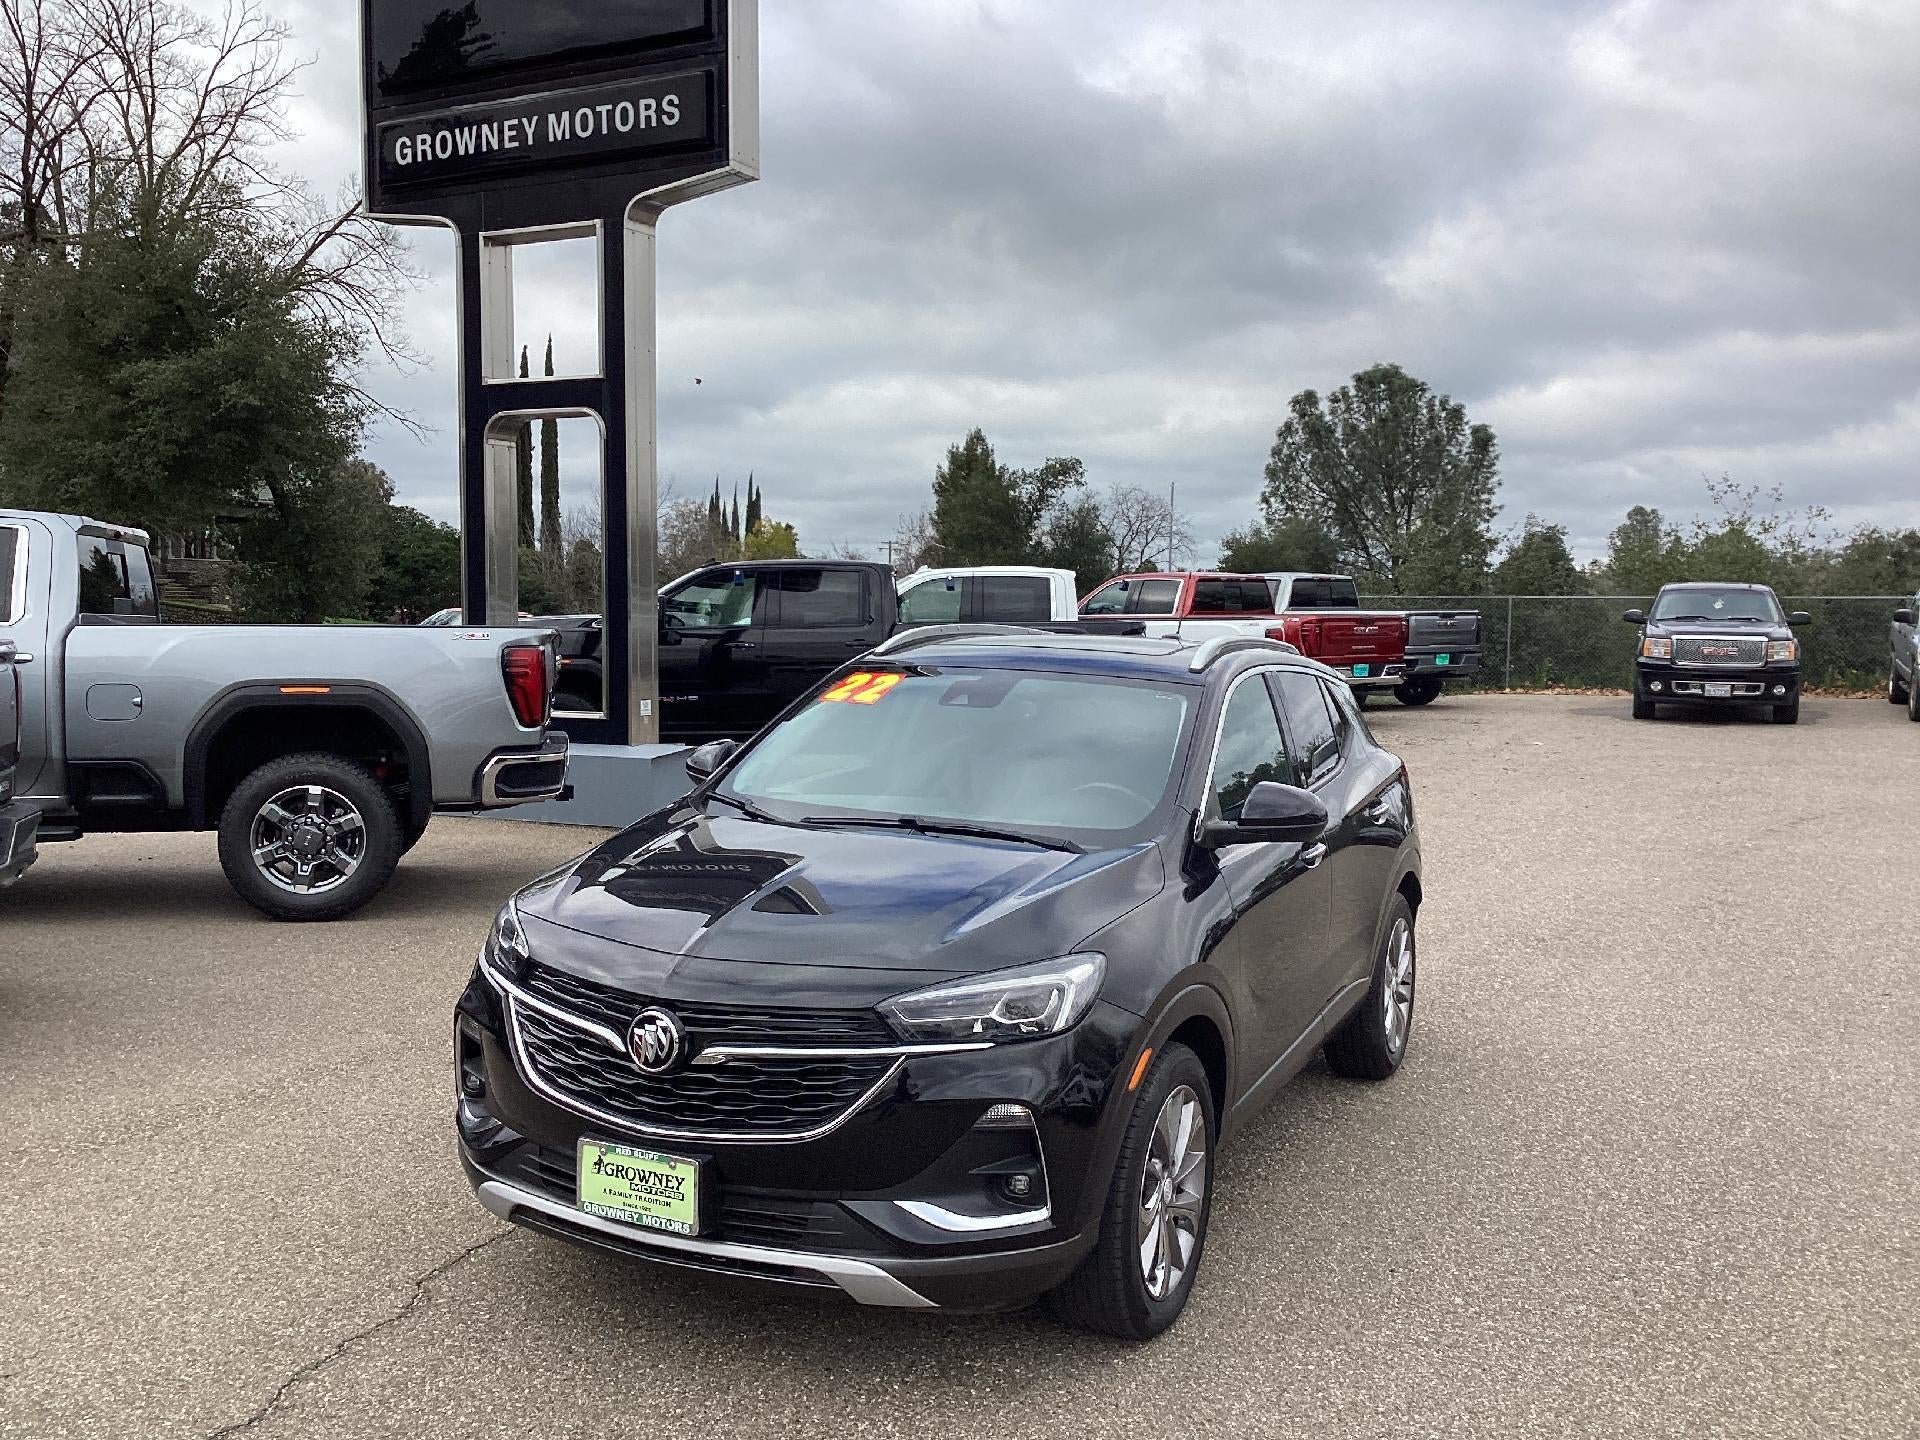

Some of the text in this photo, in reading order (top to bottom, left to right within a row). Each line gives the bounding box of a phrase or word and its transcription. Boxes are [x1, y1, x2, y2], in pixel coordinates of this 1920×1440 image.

[395, 94, 681, 166] GROWNEY MOTORS
[822, 673, 900, 703] 22
[615, 1147, 659, 1161] RED BLUFF
[604, 1162, 685, 1191] GROWNEY
[608, 1189, 633, 1201] FAMILY
[634, 1194, 672, 1208] TRADITION
[630, 1183, 684, 1200] MOTORS
[583, 1202, 690, 1233] GROWNEY MOTORS
